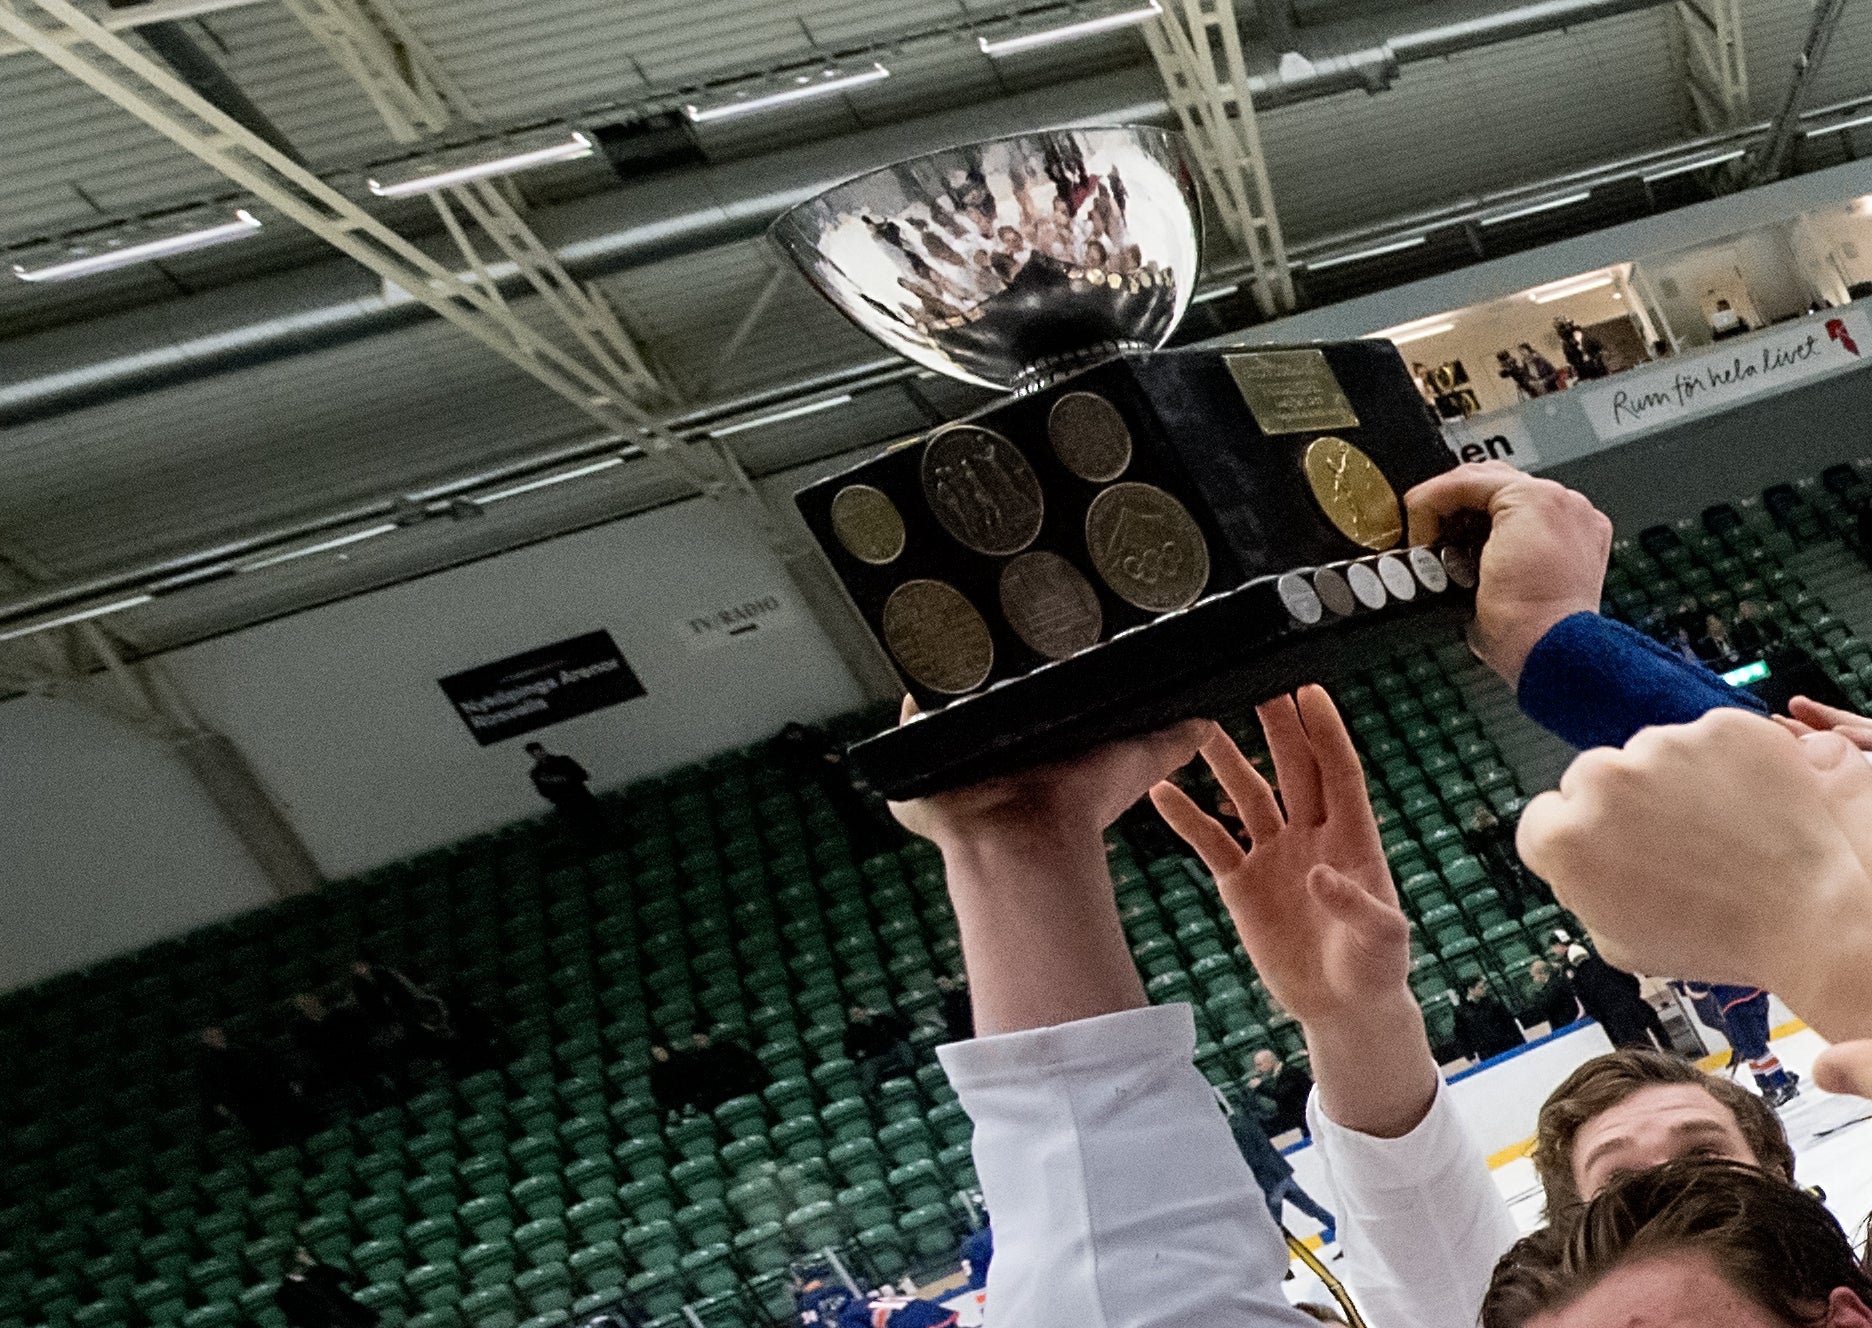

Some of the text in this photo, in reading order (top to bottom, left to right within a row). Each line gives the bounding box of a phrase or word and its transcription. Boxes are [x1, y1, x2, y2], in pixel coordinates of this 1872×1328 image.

[1613, 335, 1820, 425] Rum för hela livet
